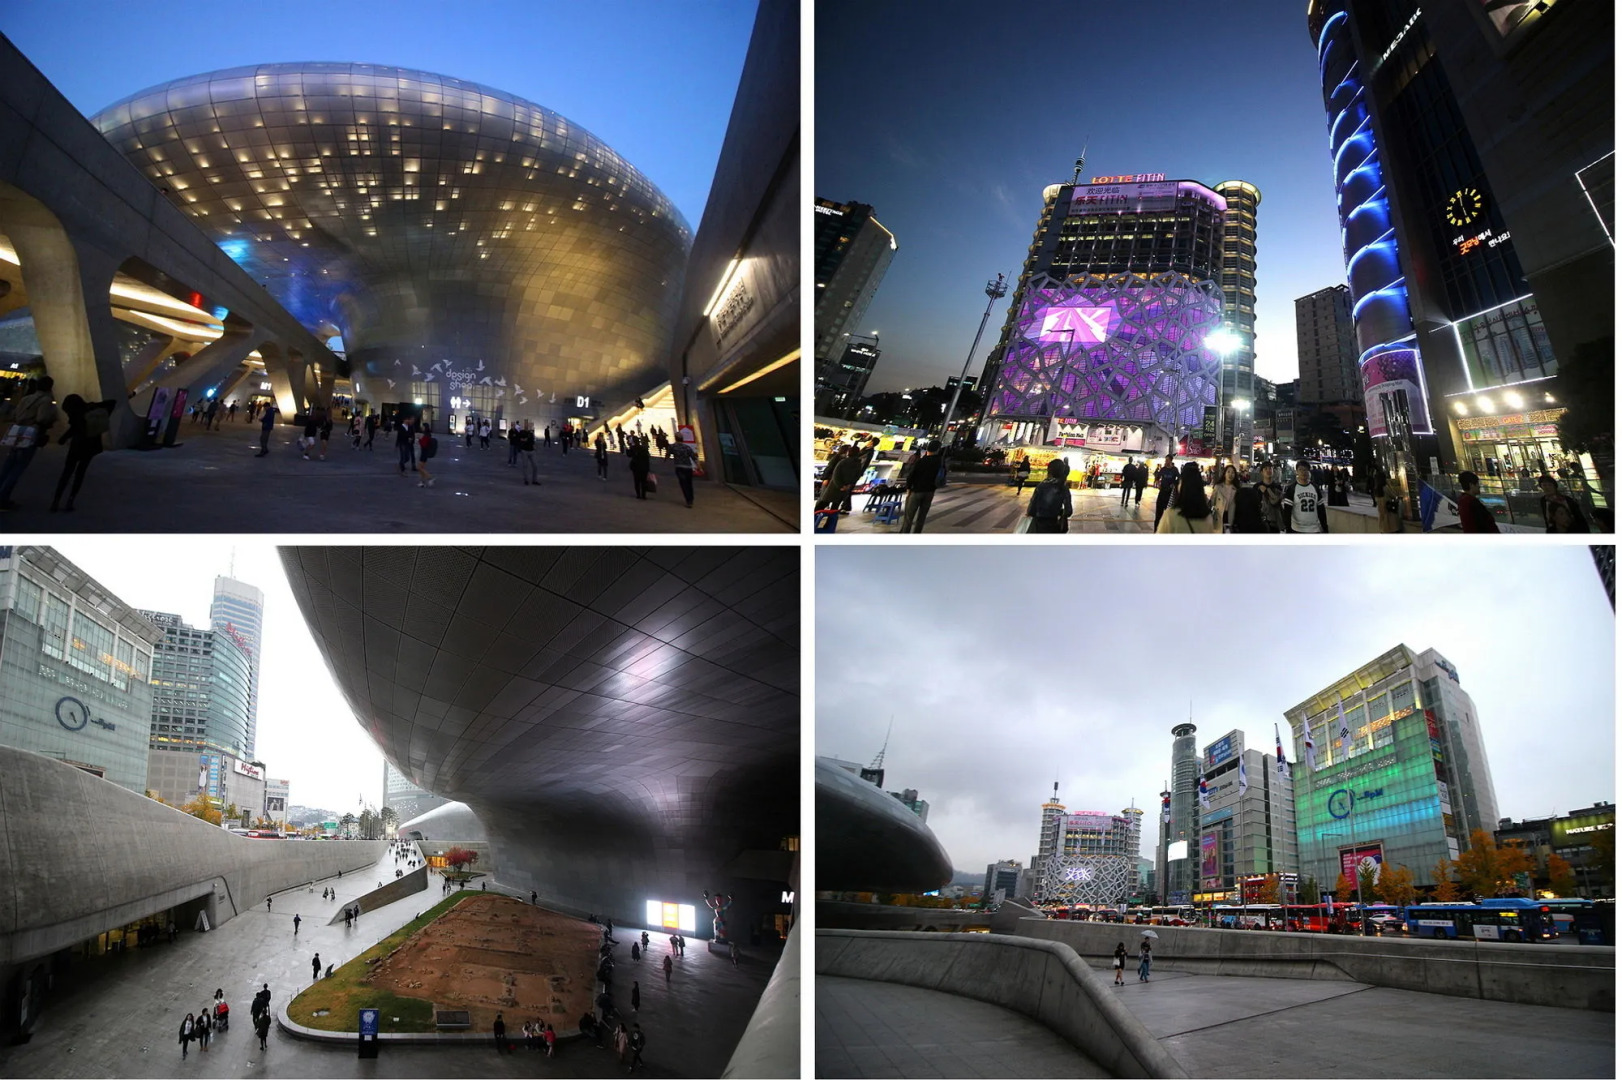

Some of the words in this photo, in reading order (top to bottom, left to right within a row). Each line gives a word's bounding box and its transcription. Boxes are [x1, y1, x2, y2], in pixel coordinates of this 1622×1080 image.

[1091, 174, 1134, 184] LOTTE
[1136, 172, 1166, 183] FITIN
[445, 369, 477, 382] design
[449, 379, 473, 391] shop
[576, 395, 590, 408] D1
[1300, 498, 1316, 513] 22
